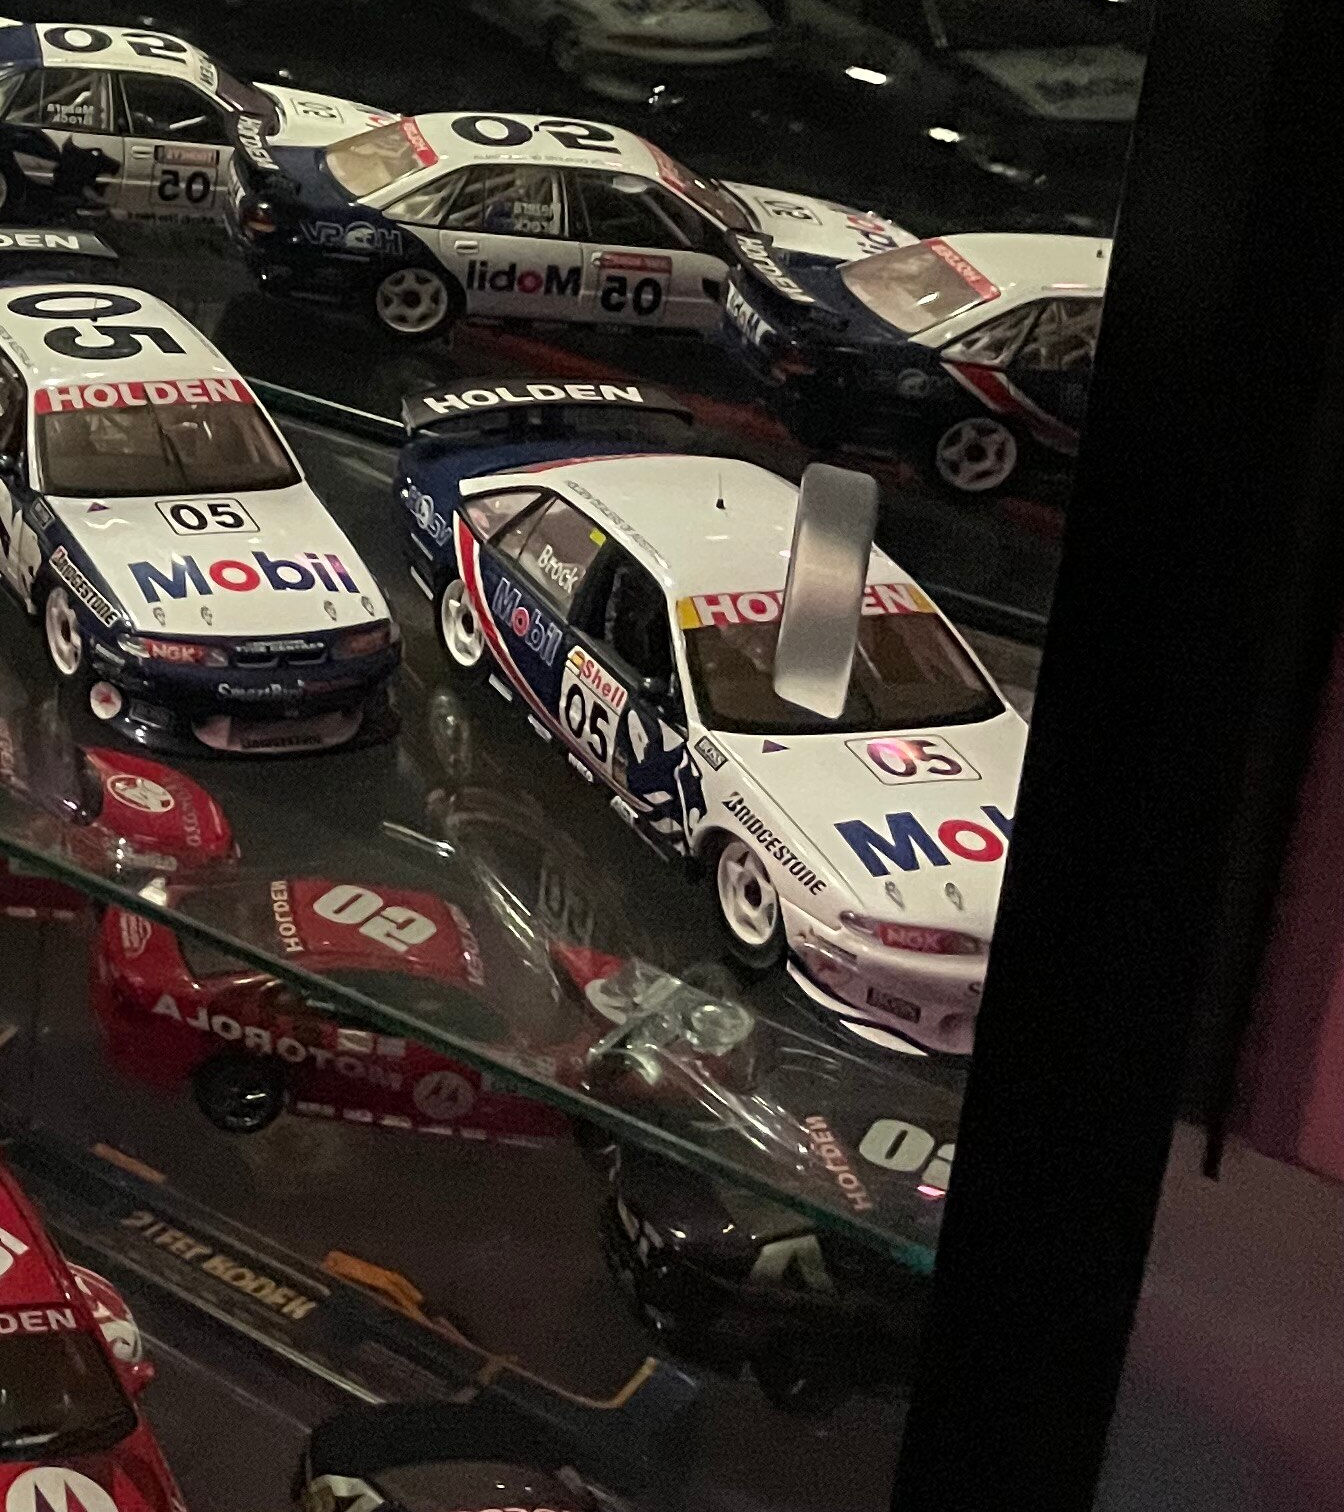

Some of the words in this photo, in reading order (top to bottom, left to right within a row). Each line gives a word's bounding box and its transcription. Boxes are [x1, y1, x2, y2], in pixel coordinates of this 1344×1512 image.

[7, 290, 187, 361] 05
[50, 377, 241, 411] HOLDEN
[423, 383, 644, 414] HOLDEN
[169, 500, 246, 531] 05
[127, 550, 360, 604] Mobil
[537, 543, 579, 594] Brock
[492, 576, 564, 667] Mobil
[580, 659, 627, 709] Shell
[564, 683, 611, 764] 05
[866, 737, 964, 778] 05
